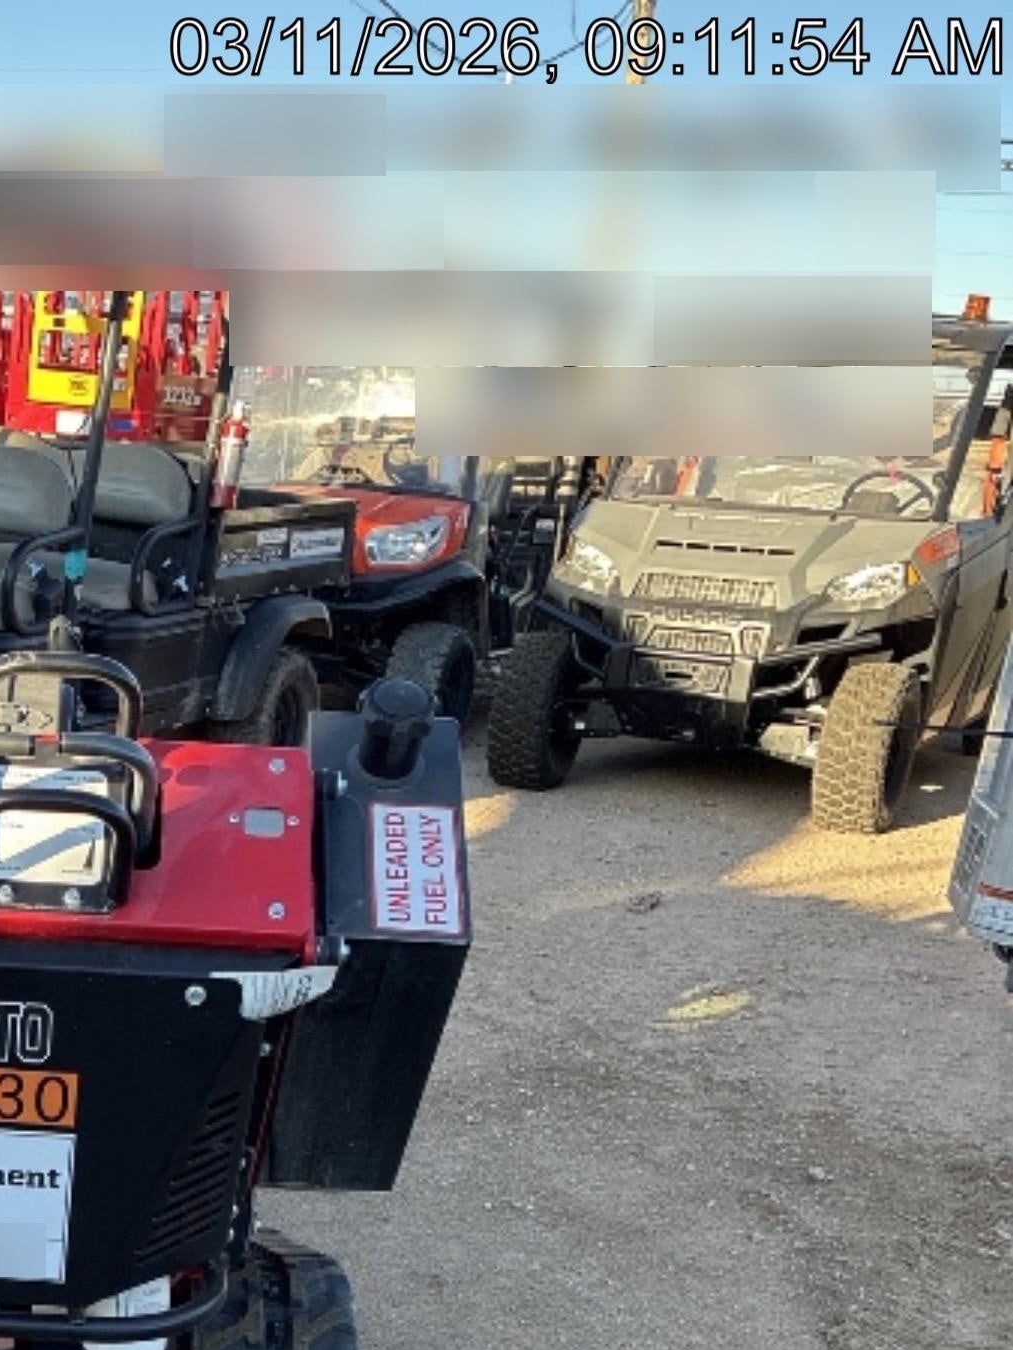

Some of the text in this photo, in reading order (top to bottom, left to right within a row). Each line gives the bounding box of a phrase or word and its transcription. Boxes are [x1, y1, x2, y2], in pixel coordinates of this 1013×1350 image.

[385, 812, 411, 922] UNLEADED
[420, 812, 448, 925] FUEL ONLY
